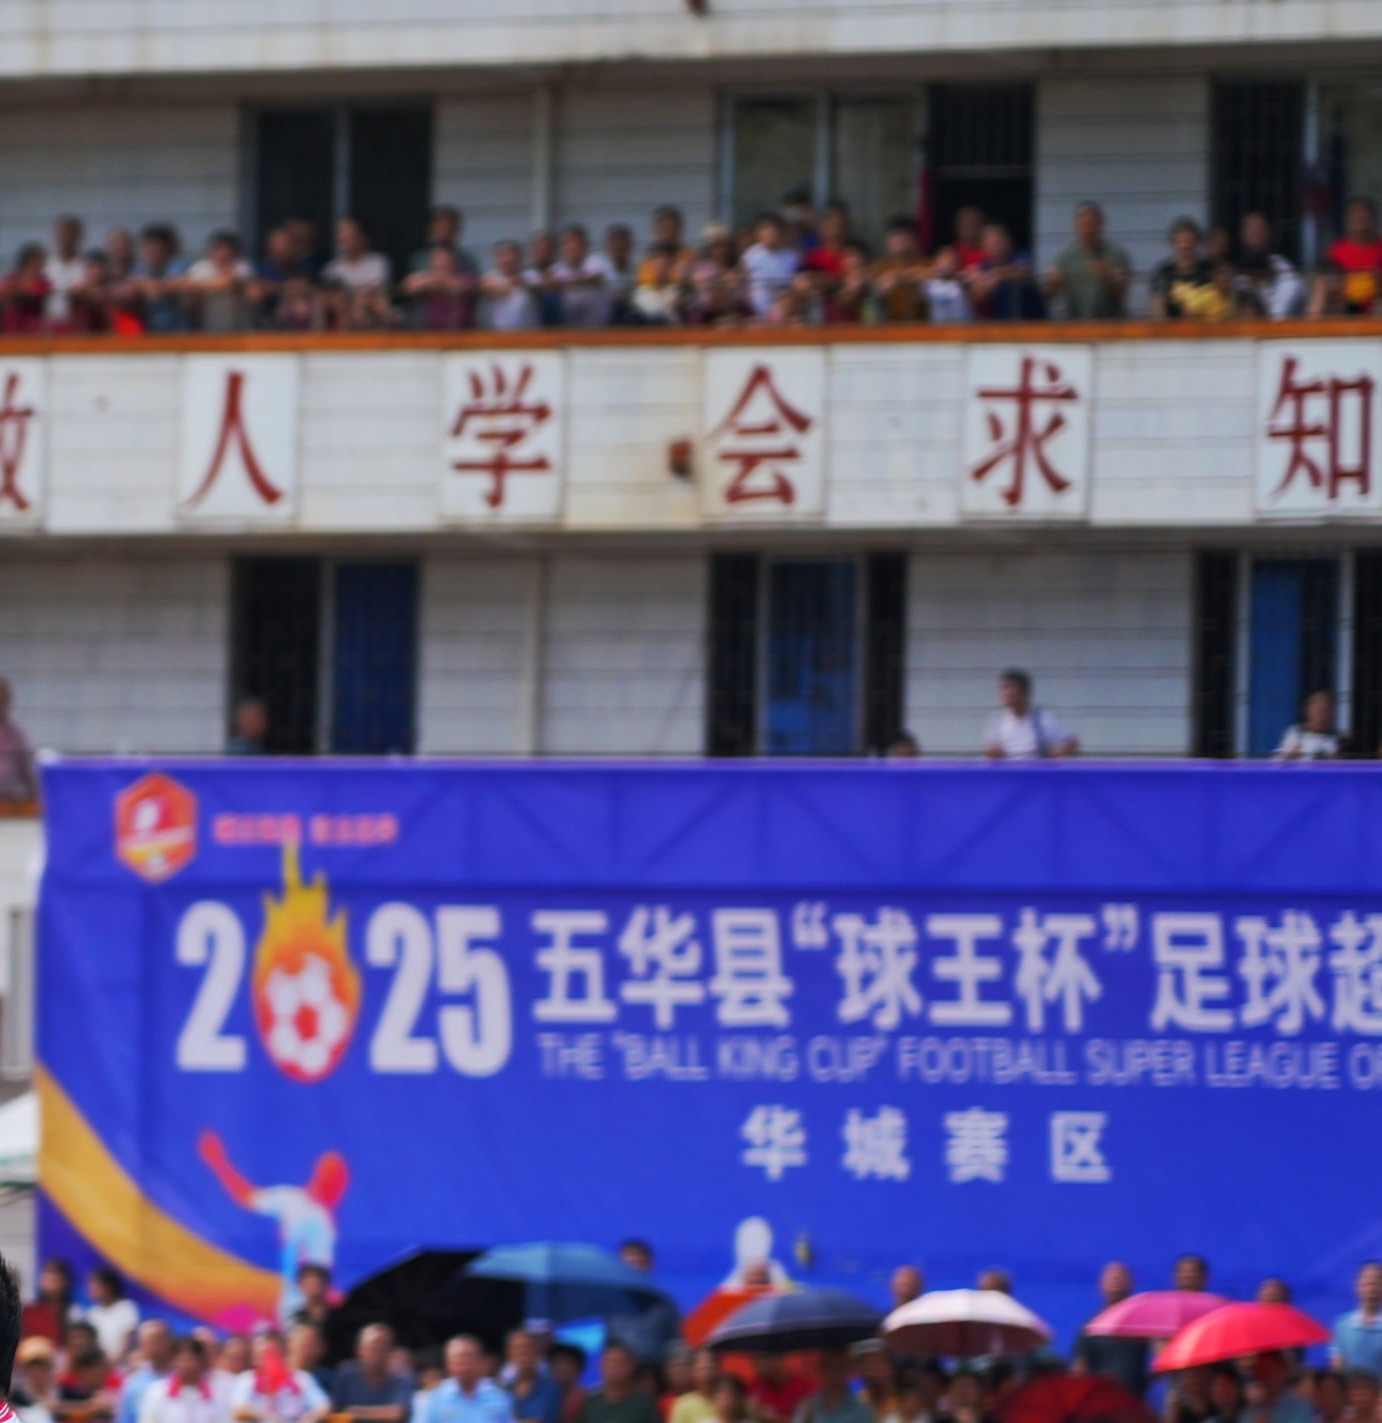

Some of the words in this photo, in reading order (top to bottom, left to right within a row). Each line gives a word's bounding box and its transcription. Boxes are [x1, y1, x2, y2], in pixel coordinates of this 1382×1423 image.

[537, 1033, 604, 1082] THE
[718, 1035, 800, 1082] KING
[898, 1036, 1077, 1085] FOOTBALL
[1086, 1038, 1196, 1087] SUPER
[1206, 1040, 1340, 1090] LEAGUE
[740, 1104, 1112, 1184] 华城赛区
